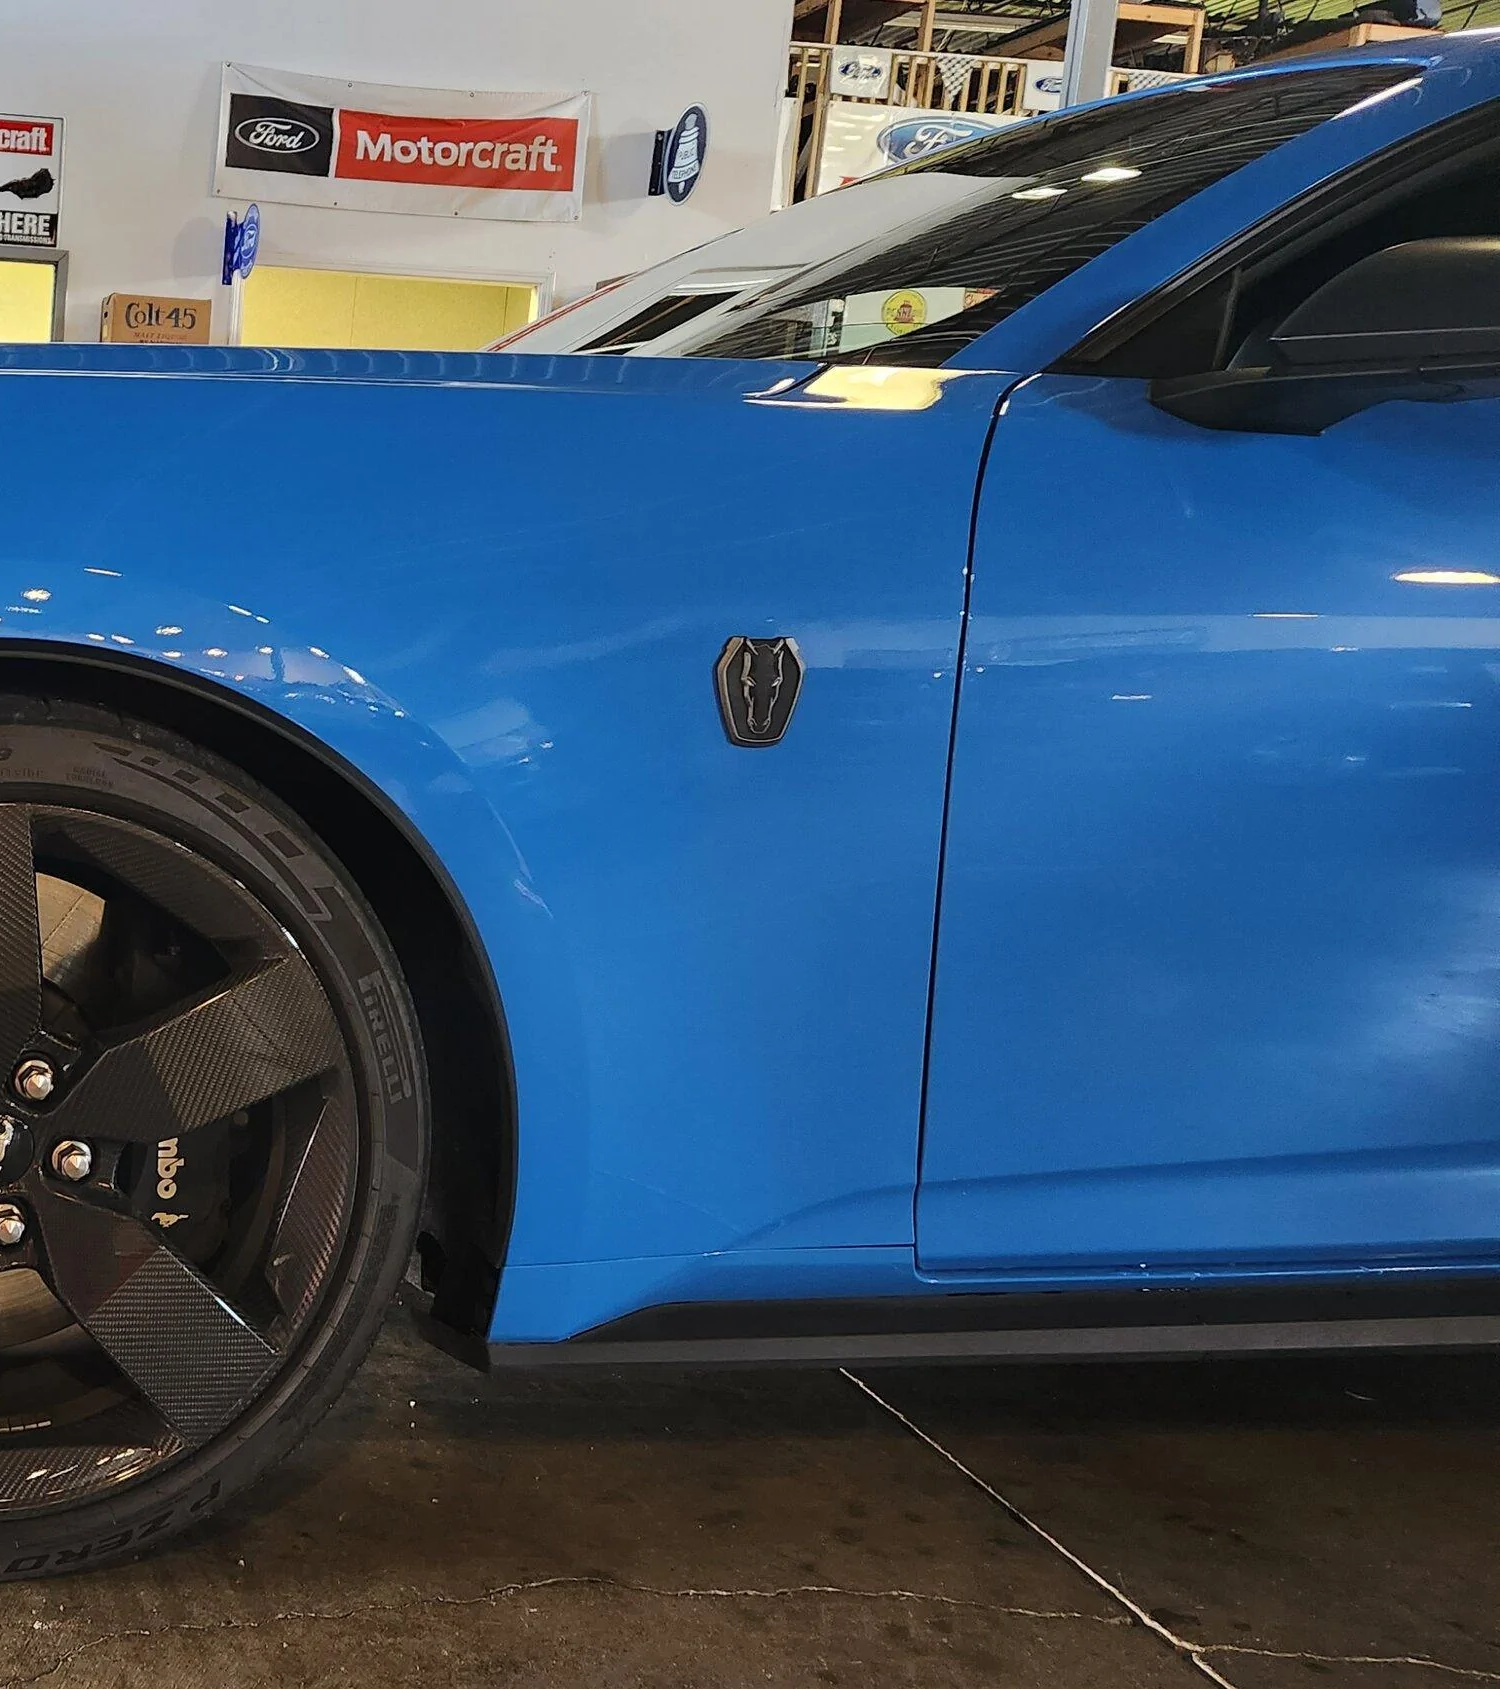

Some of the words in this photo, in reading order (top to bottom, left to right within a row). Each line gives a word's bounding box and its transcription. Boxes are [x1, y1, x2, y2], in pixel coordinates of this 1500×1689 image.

[248, 119, 305, 151] Ford
[356, 129, 559, 173] Motorcraft
[125, 302, 166, 329] Colt
[165, 307, 197, 330] 45
[357, 968, 412, 1105] PIRELLI
[157, 1136, 185, 1200] mbo
